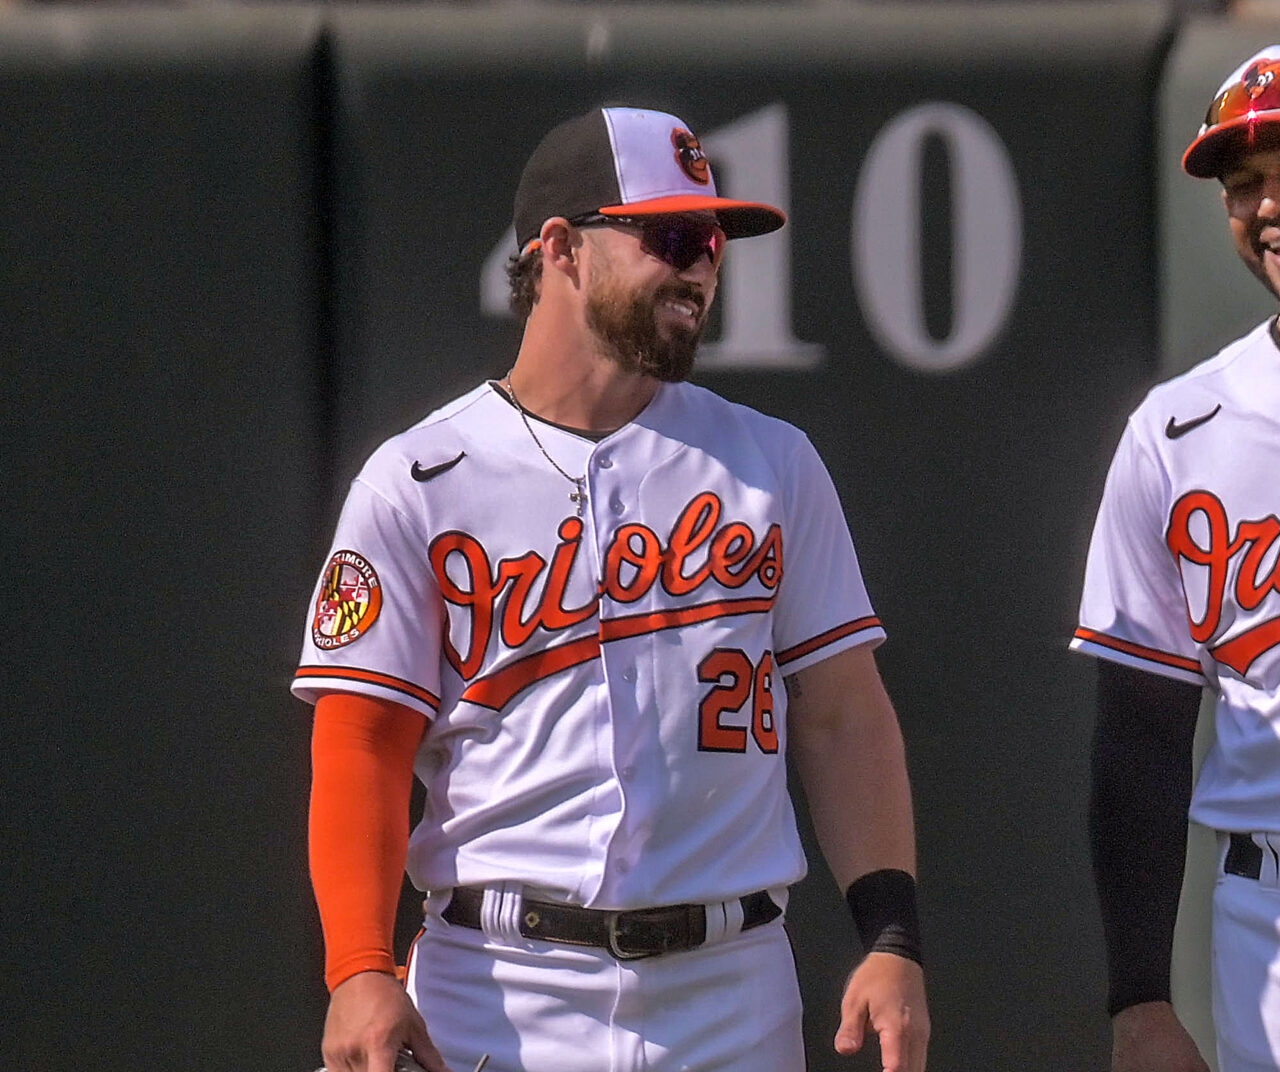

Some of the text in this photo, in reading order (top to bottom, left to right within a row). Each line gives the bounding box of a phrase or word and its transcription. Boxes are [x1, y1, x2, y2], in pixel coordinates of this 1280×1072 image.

[479, 101, 1025, 373] 10
[427, 490, 785, 681] Orioles
[697, 647, 780, 755] 26
